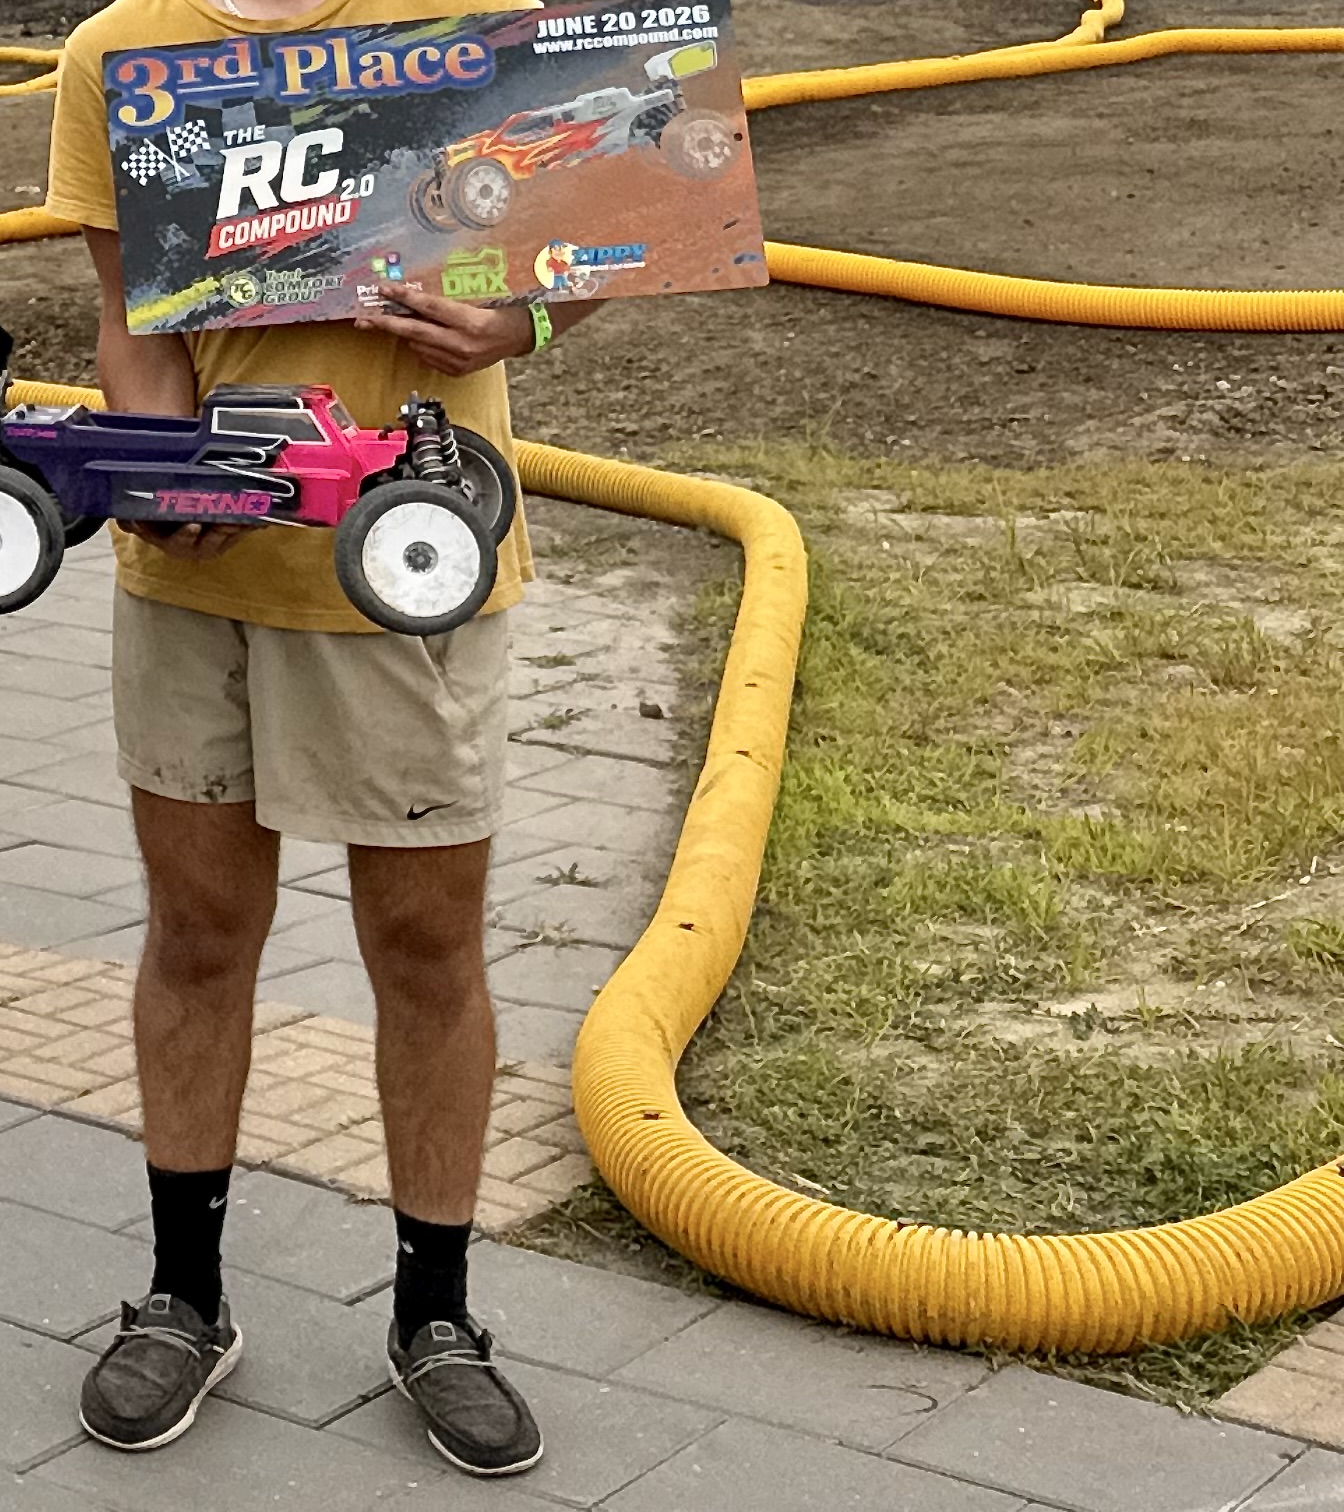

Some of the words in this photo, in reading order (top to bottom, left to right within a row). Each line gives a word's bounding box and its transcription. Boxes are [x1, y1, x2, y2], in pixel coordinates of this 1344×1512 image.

[537, 15, 598, 39] JUNE
[600, 11, 637, 33] 20
[641, 4, 711, 30] 2026
[532, 25, 719, 55] www.rccompound.com
[116, 40, 259, 127] 3rd
[275, 37, 487, 97] Place
[224, 124, 266, 146] THE
[216, 127, 344, 220] RC
[339, 174, 375, 202] 2.0
[218, 201, 352, 249] COMPOUND
[263, 288, 324, 305] GROUP
[440, 271, 510, 296] DMX
[155, 489, 272, 516] TEKNO
